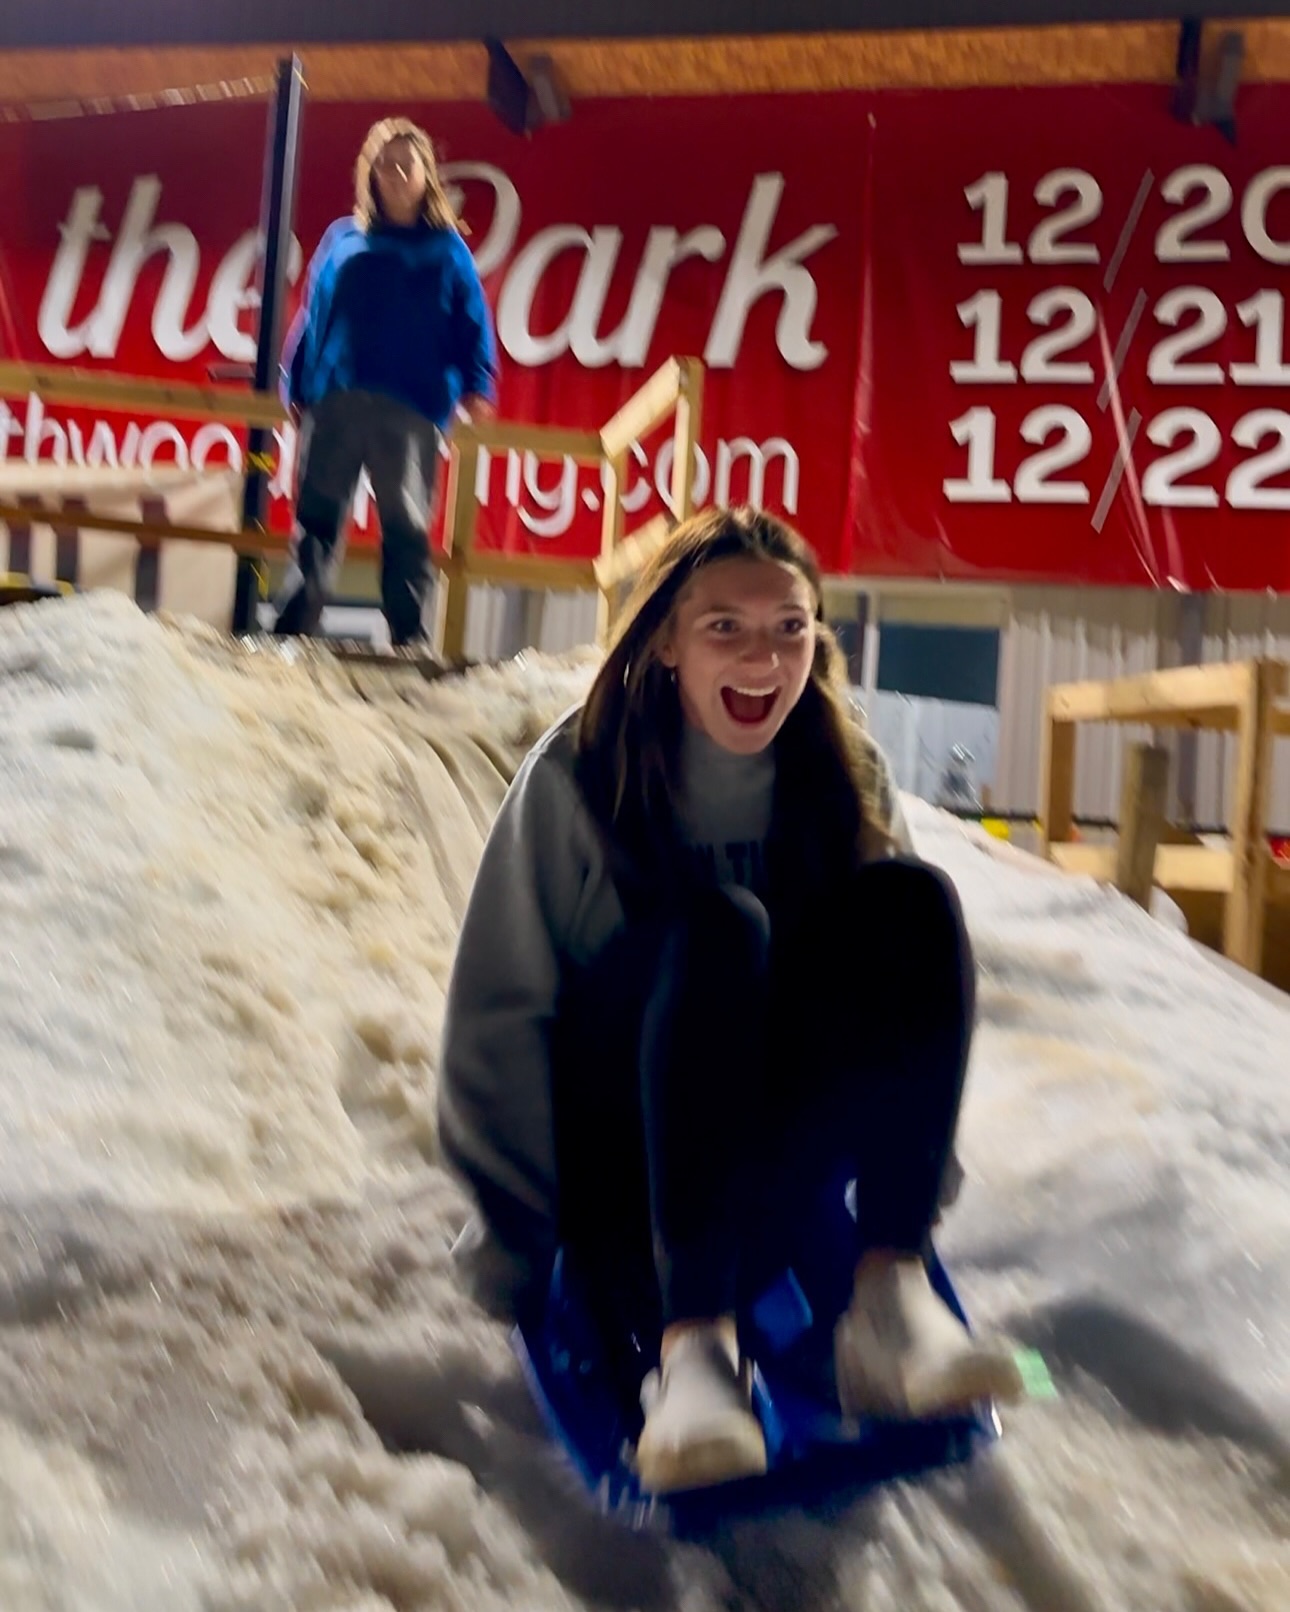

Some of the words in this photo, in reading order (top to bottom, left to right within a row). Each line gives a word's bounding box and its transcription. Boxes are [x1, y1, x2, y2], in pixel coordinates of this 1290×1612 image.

[38, 173, 302, 362] the
[957, 165, 1290, 293] 12/20
[949, 284, 1290, 412] 12/21
[942, 402, 1290, 534] 12/22
